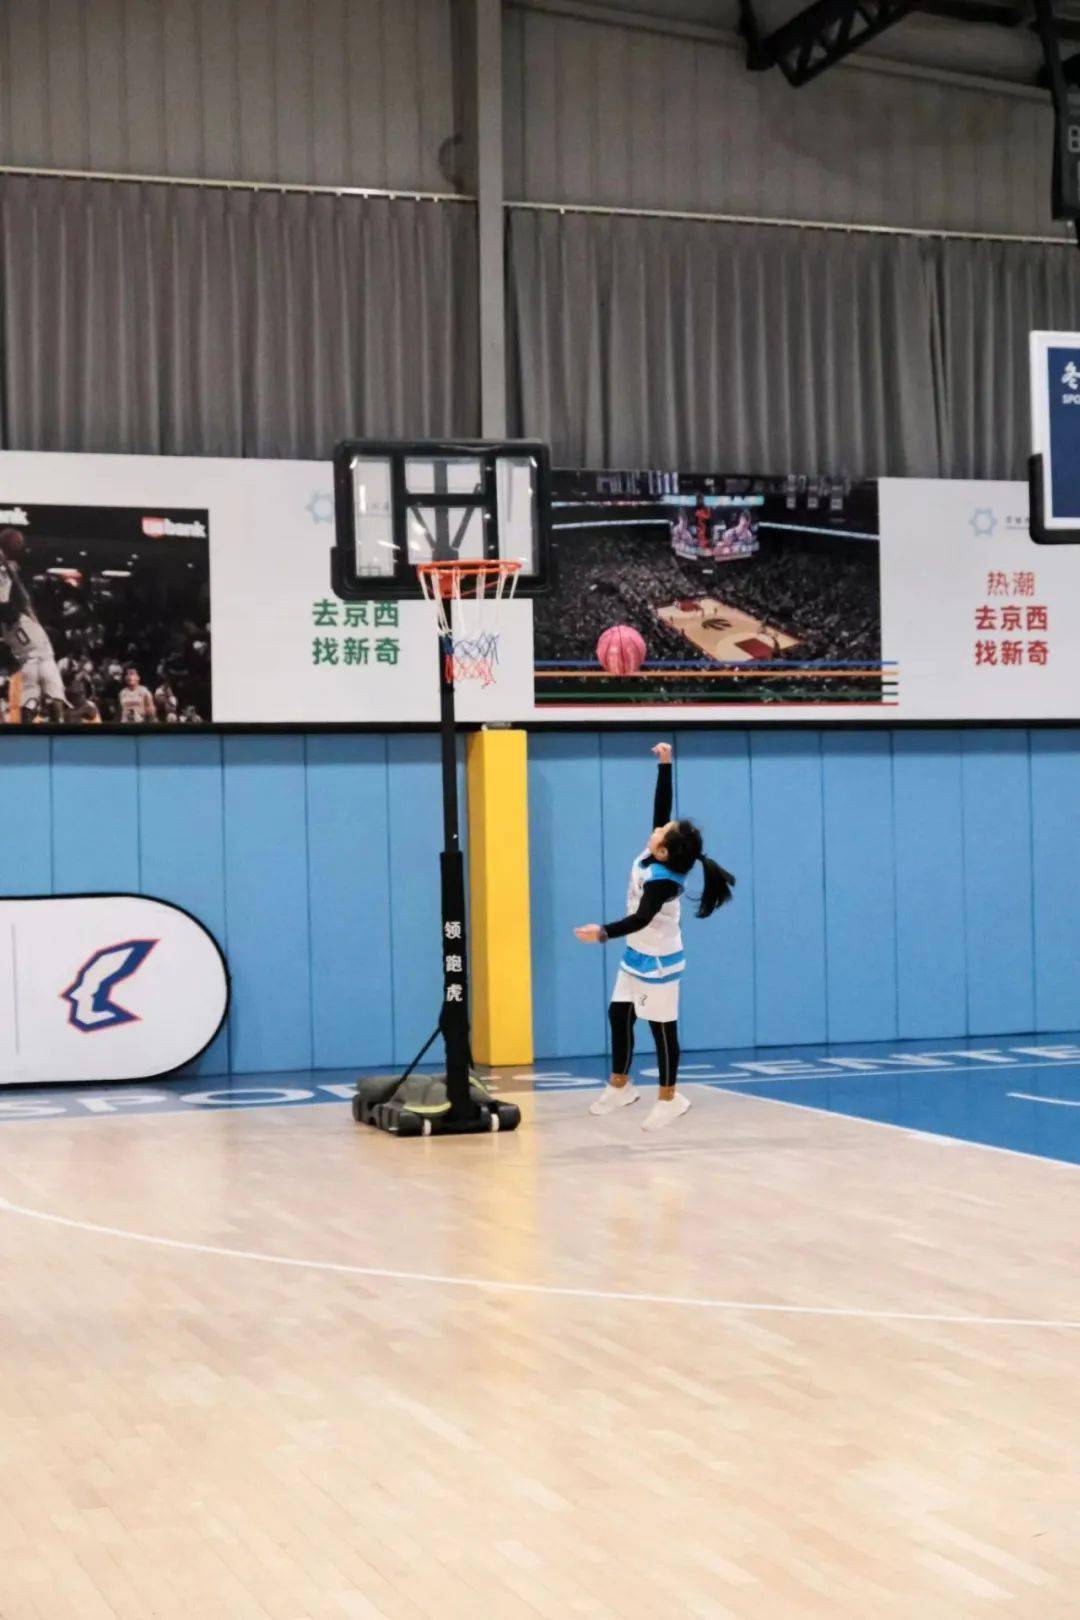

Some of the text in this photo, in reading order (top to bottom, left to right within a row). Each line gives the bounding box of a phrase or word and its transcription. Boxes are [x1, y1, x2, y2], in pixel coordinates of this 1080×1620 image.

[986, 571, 1036, 597] 热潮
[312, 599, 399, 628] 去京西
[975, 605, 1048, 631] 去京西
[312, 637, 400, 666] 找新奇
[975, 640, 1050, 666] 找新奇
[444, 921, 463, 1002] 领跑虎
